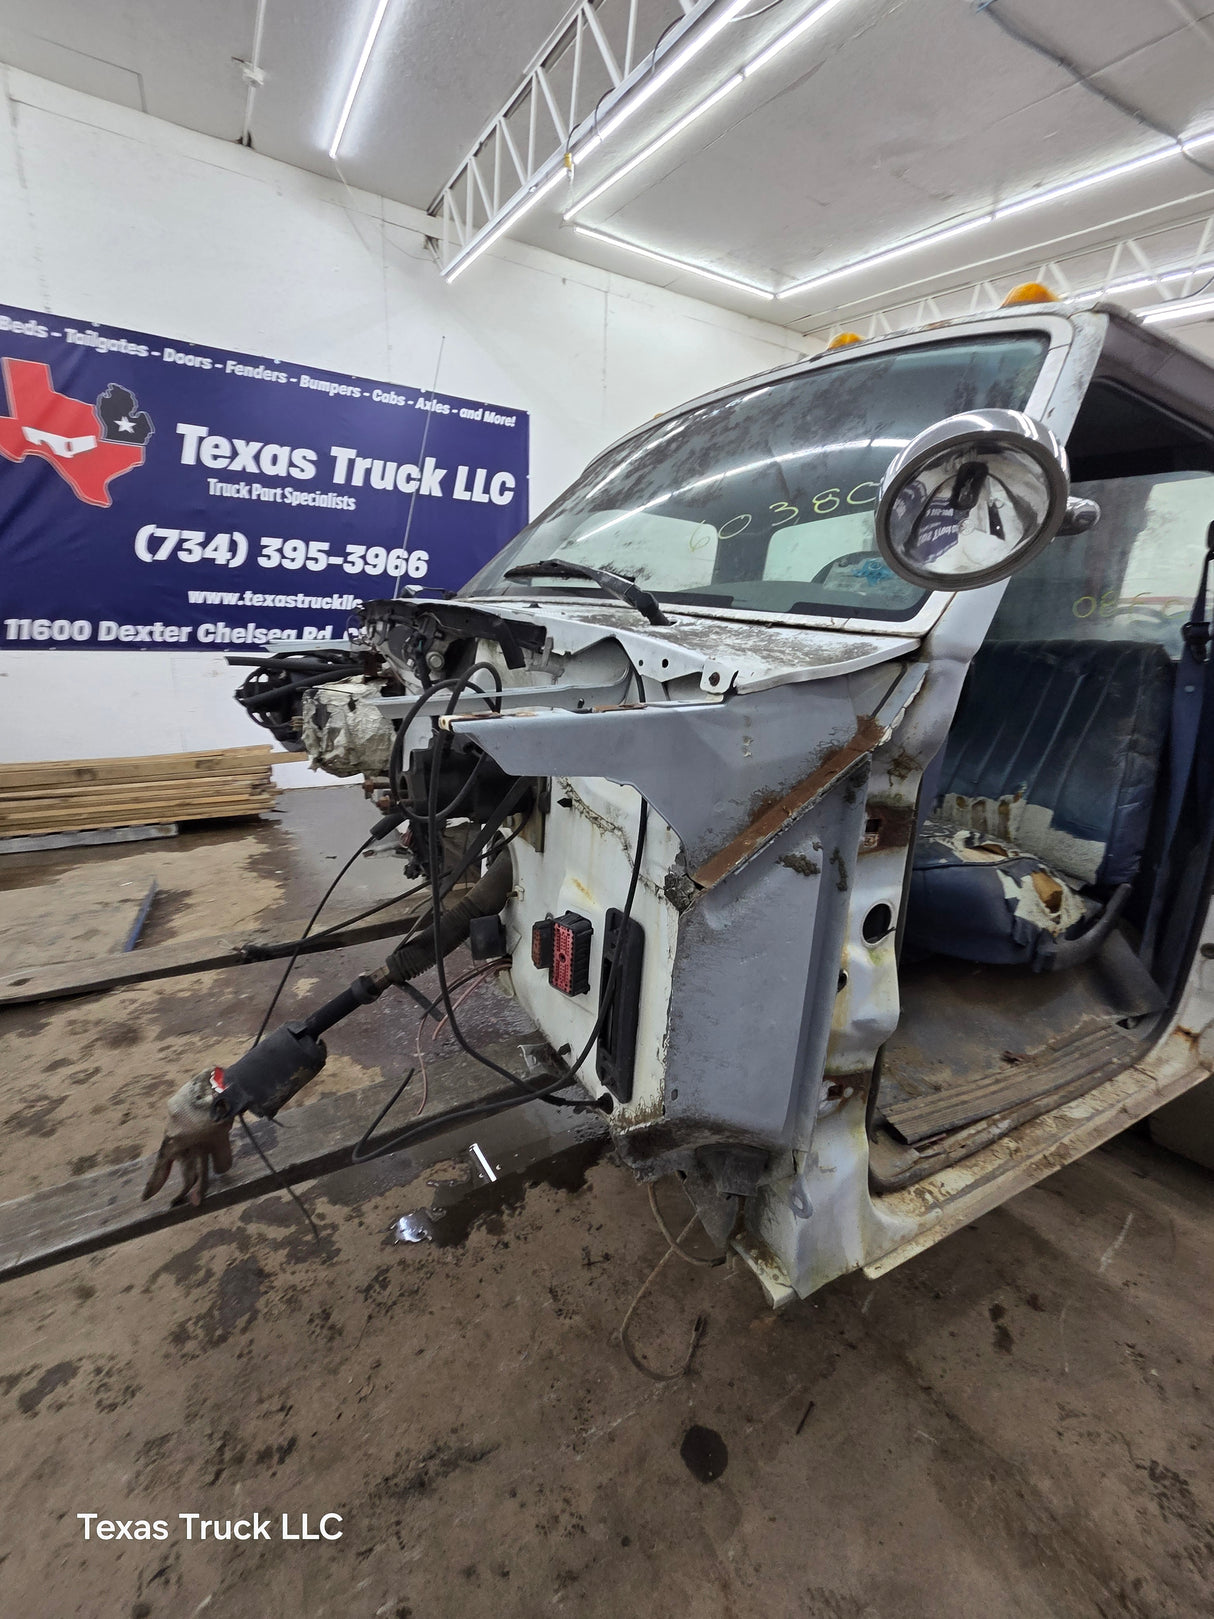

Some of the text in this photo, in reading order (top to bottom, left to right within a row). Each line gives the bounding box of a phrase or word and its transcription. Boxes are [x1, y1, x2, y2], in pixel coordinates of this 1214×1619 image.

[0, 315, 49, 338] Beds
[64, 327, 149, 357] Tailgates
[163, 348, 213, 369] Doors
[225, 361, 288, 383] Fenders
[300, 374, 362, 397] Bumpers
[372, 389, 406, 406] Cabs
[415, 397, 450, 415] Axles
[459, 408, 483, 421] and
[483, 411, 517, 427] More!
[175, 422, 516, 506] Texas Truck LLC
[207, 478, 357, 511] Truck Part Specialists
[134, 524, 430, 579] (734) 395-3966
[3, 618, 93, 642] 11600
[97, 620, 193, 643] Dexter
